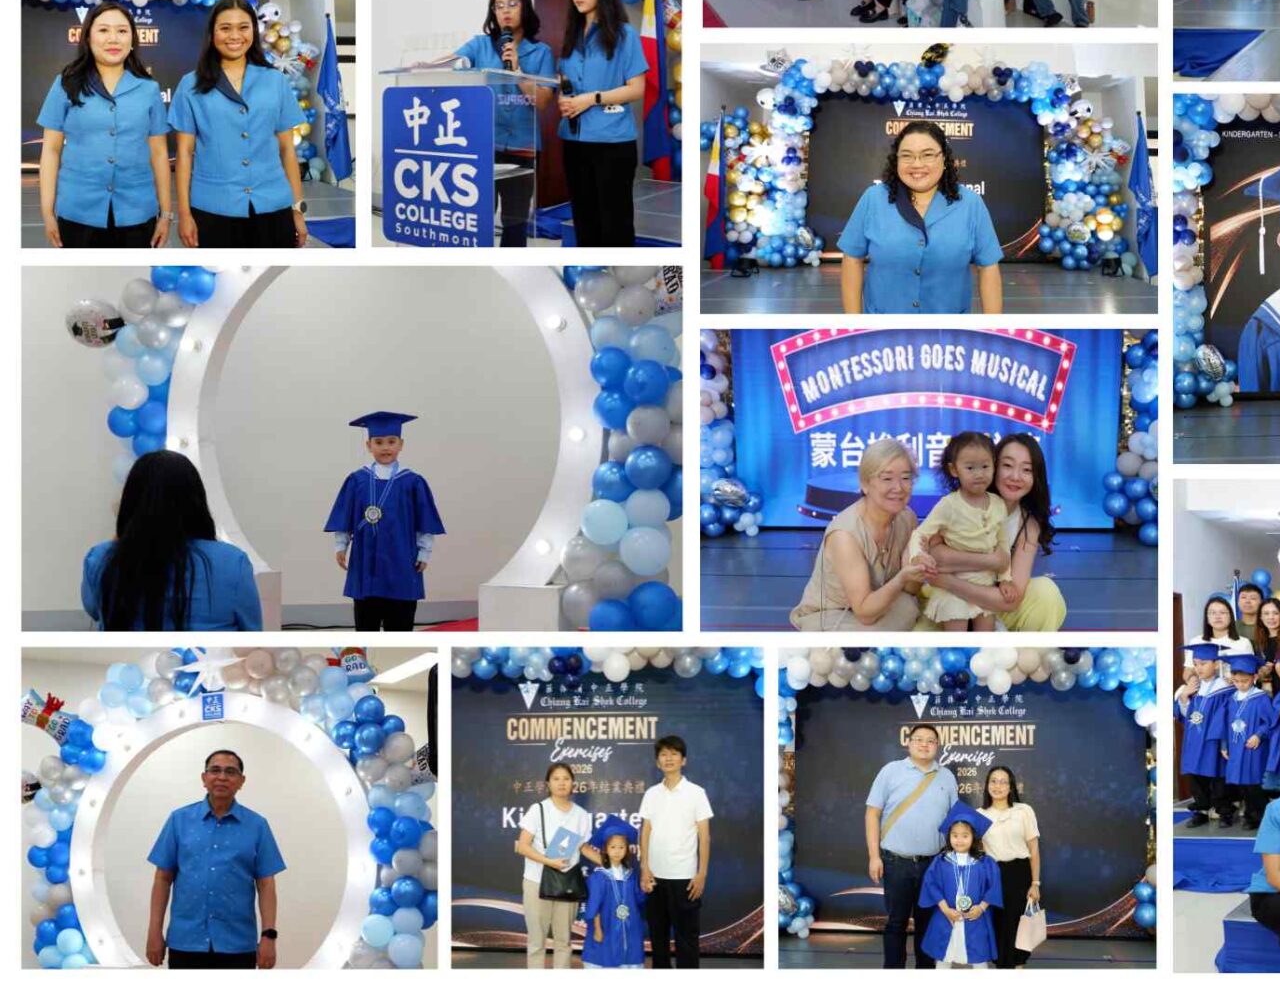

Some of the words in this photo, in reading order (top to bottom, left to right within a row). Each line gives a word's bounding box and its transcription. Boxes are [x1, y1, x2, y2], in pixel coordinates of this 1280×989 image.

[403, 96, 468, 147] 中正
[1221, 130, 1273, 138] KINDERGARTEN
[394, 158, 479, 207] CKS
[395, 203, 478, 232] COLLEGE
[395, 222, 479, 247] Southmont
[662, 264, 680, 294] RAD
[801, 345, 914, 403] MONTESSORI
[920, 344, 966, 371] GOES
[970, 349, 1048, 402] MUSICAL
[345, 661, 366, 672] RAD
[540, 695, 571, 709] Chiang
[573, 695, 589, 706] Kai
[592, 695, 614, 708] Shek
[616, 695, 648, 708] College
[930, 706, 958, 717] Chiang
[959, 706, 974, 716] Kai
[977, 706, 997, 716] Shek
[998, 706, 1026, 717] College
[506, 716, 659, 741] COMMENCEMENT
[900, 724, 1036, 746] CMENCEMENT
[550, 737, 613, 762] Exercises
[939, 744, 996, 766] Exercises
[957, 767, 978, 777] 2026
